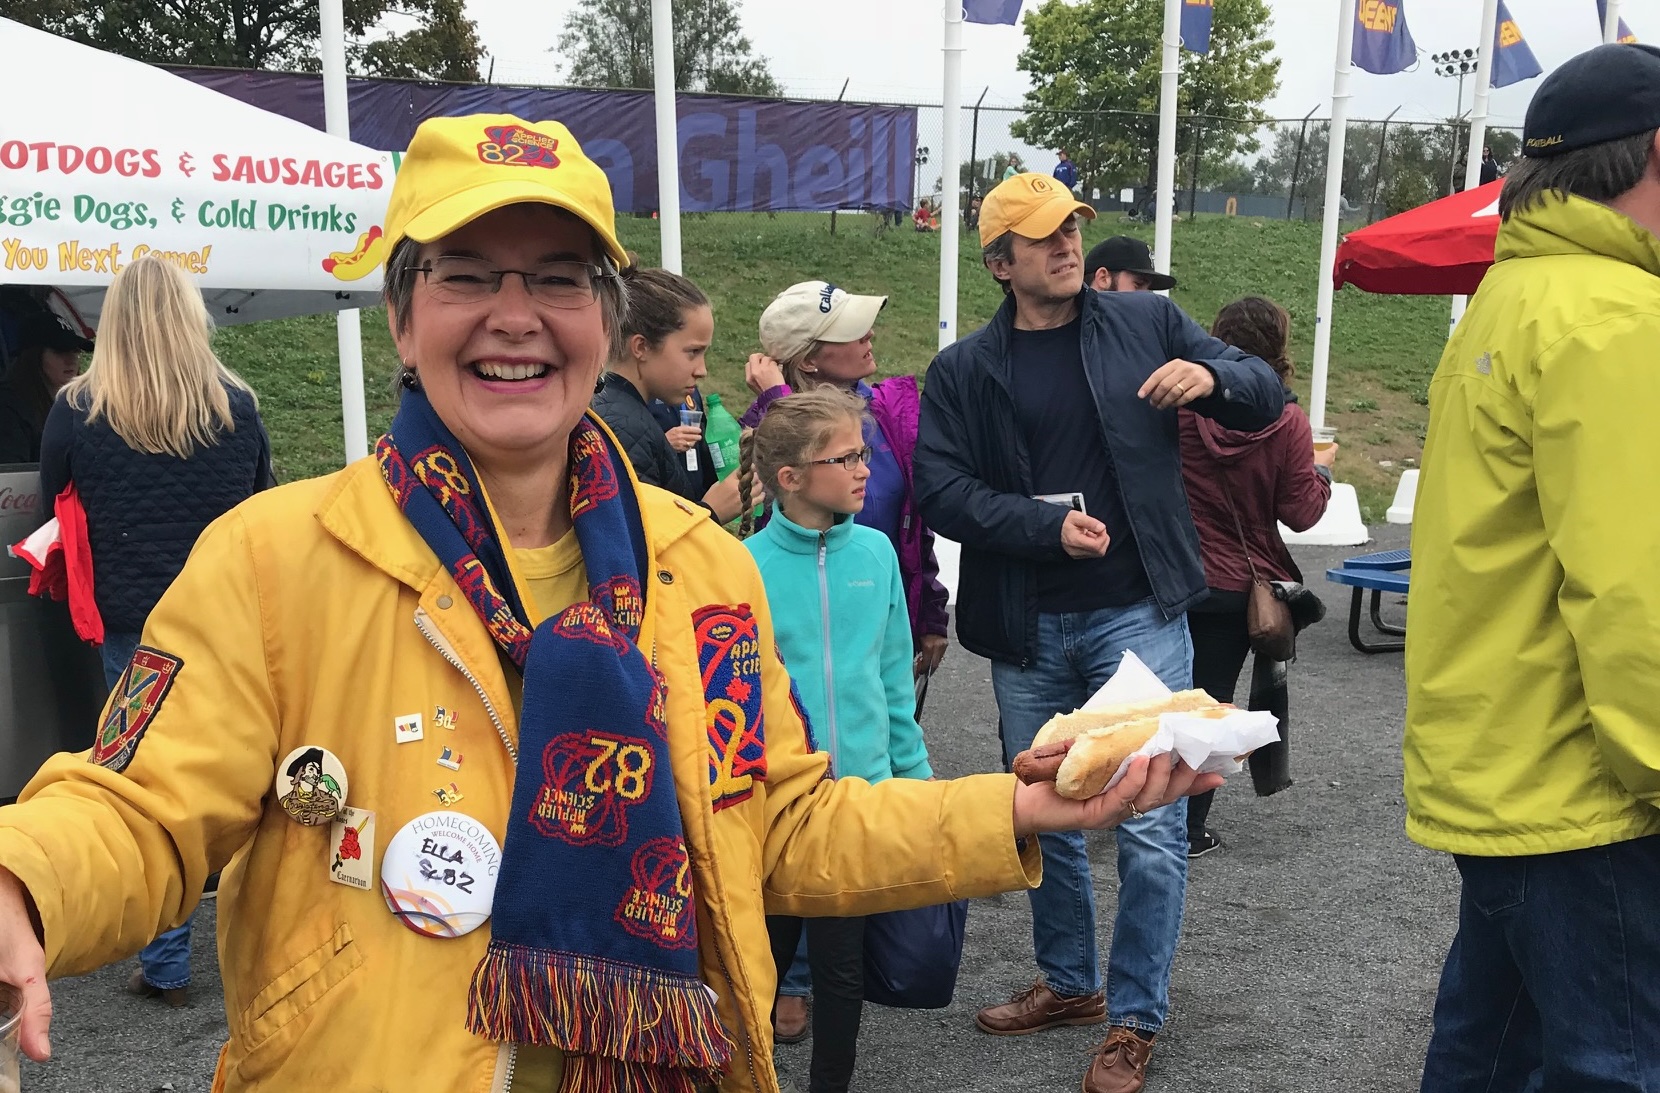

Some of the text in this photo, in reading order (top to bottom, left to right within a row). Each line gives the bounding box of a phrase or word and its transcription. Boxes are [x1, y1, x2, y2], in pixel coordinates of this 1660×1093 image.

[481, 142, 528, 165] 82
[511, 138, 554, 150] SCIENCE
[513, 132, 555, 145] APPLIED
[178, 151, 197, 178] &
[212, 153, 384, 190] SAUSAGES
[73, 194, 158, 231] Dogs,
[171, 197, 188, 224] &
[198, 199, 258, 230] Cold
[268, 203, 358, 235] Drinks
[1, 237, 48, 272] You
[58, 239, 124, 275] Next
[584, 737, 652, 800] 82
[411, 815, 500, 878] HOMECOMING
[421, 837, 464, 865] ELLA
[431, 830, 483, 864] WELCOME HOME
